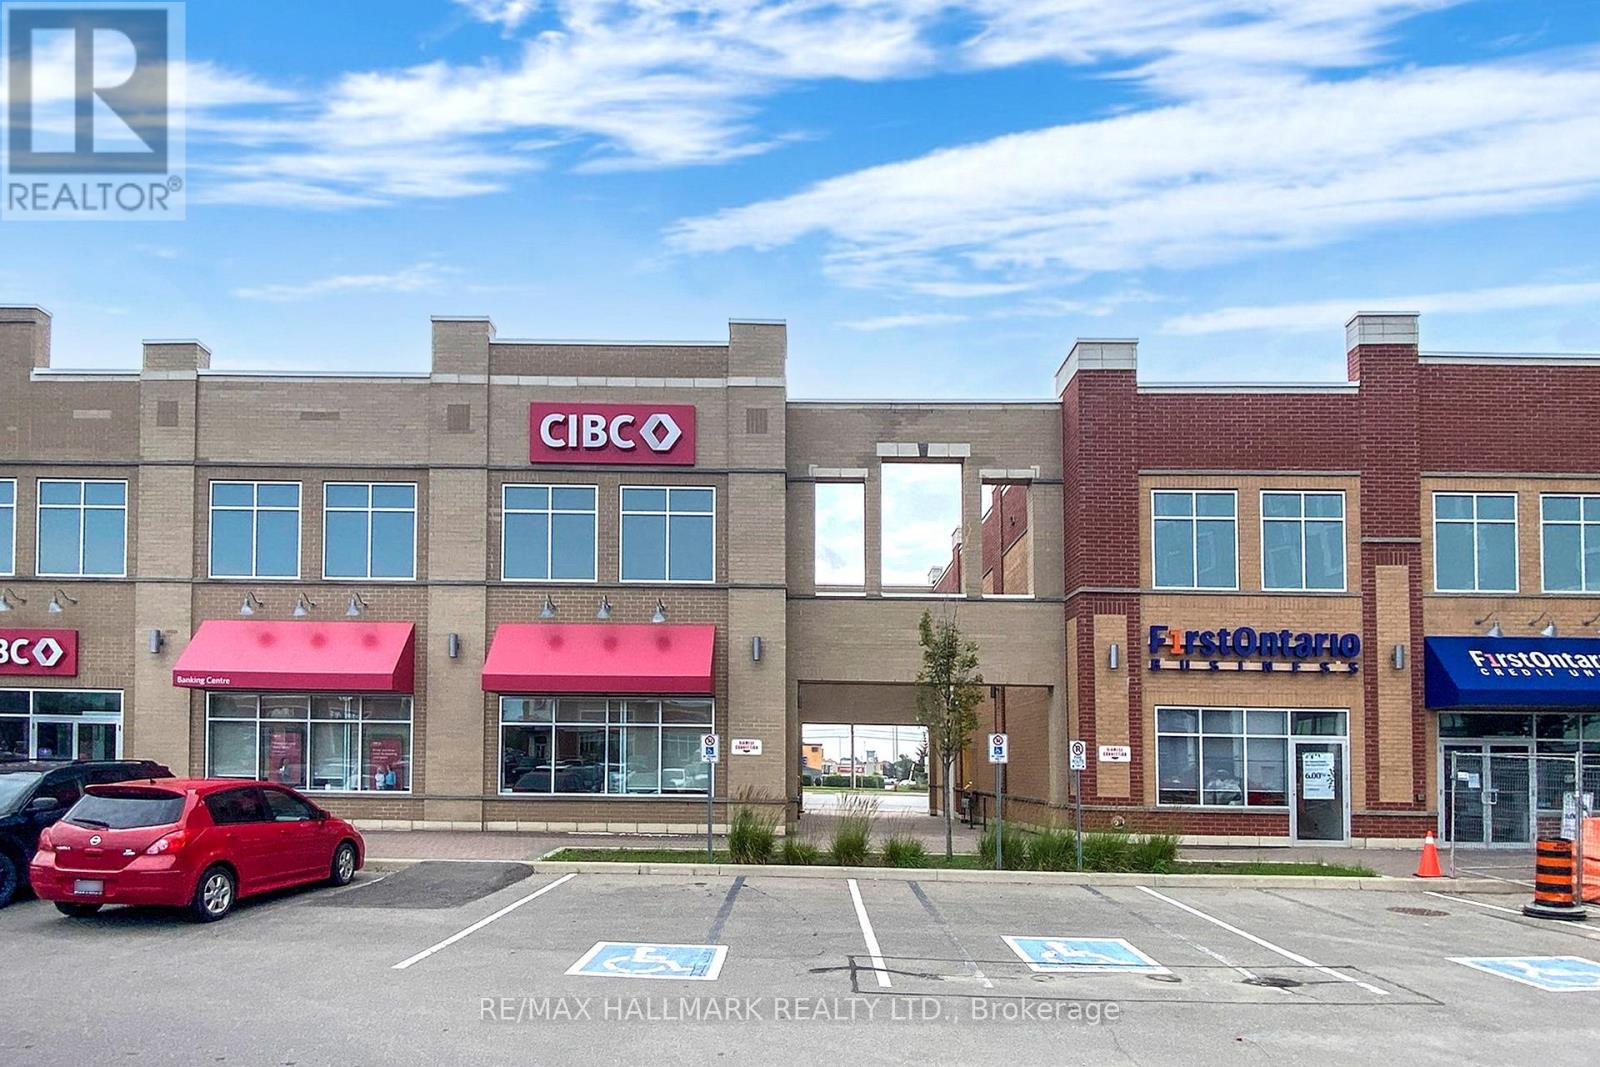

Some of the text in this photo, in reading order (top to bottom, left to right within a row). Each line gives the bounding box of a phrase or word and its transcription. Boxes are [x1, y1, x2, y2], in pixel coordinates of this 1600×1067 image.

[540, 413, 636, 449] CIBC
[1150, 658, 1359, 673] BUSINESS
[1480, 668, 1554, 677] CREDIT
[177, 676, 230, 685] Banking Centre
